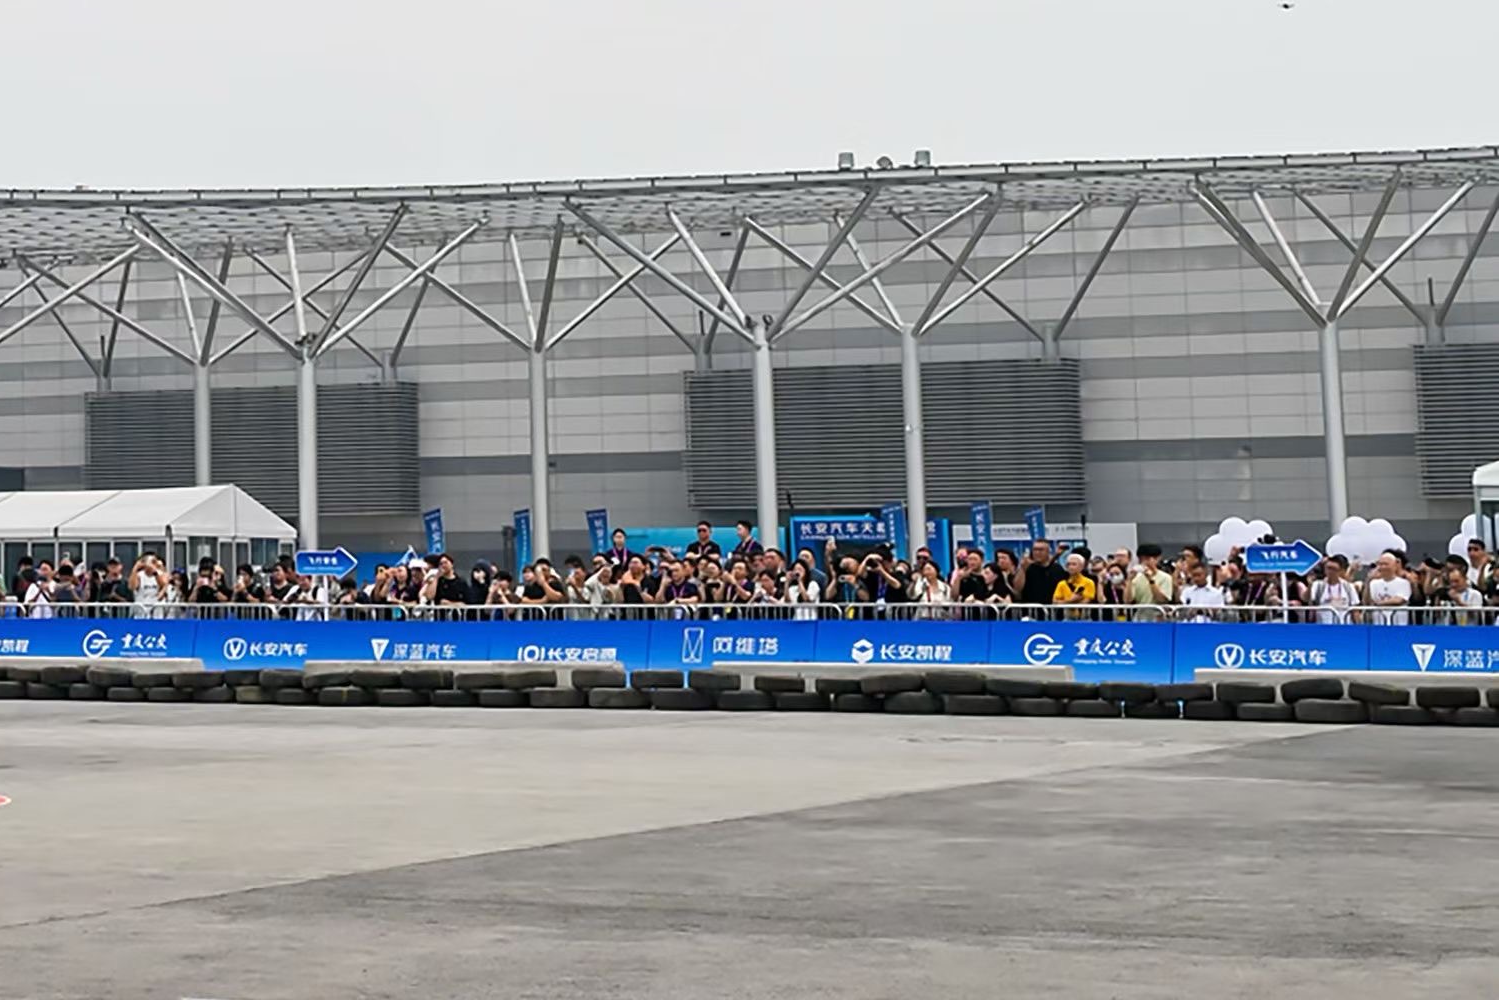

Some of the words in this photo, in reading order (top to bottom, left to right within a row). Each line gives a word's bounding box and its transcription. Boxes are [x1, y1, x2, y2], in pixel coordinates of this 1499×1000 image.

[250, 641, 308, 656] 长安汽车
[393, 643, 457, 659] 深蓝汽车
[713, 636, 779, 655] 阿维塔
[880, 644, 952, 661] 长安凯程
[1249, 648, 1327, 666] 长安汽车
